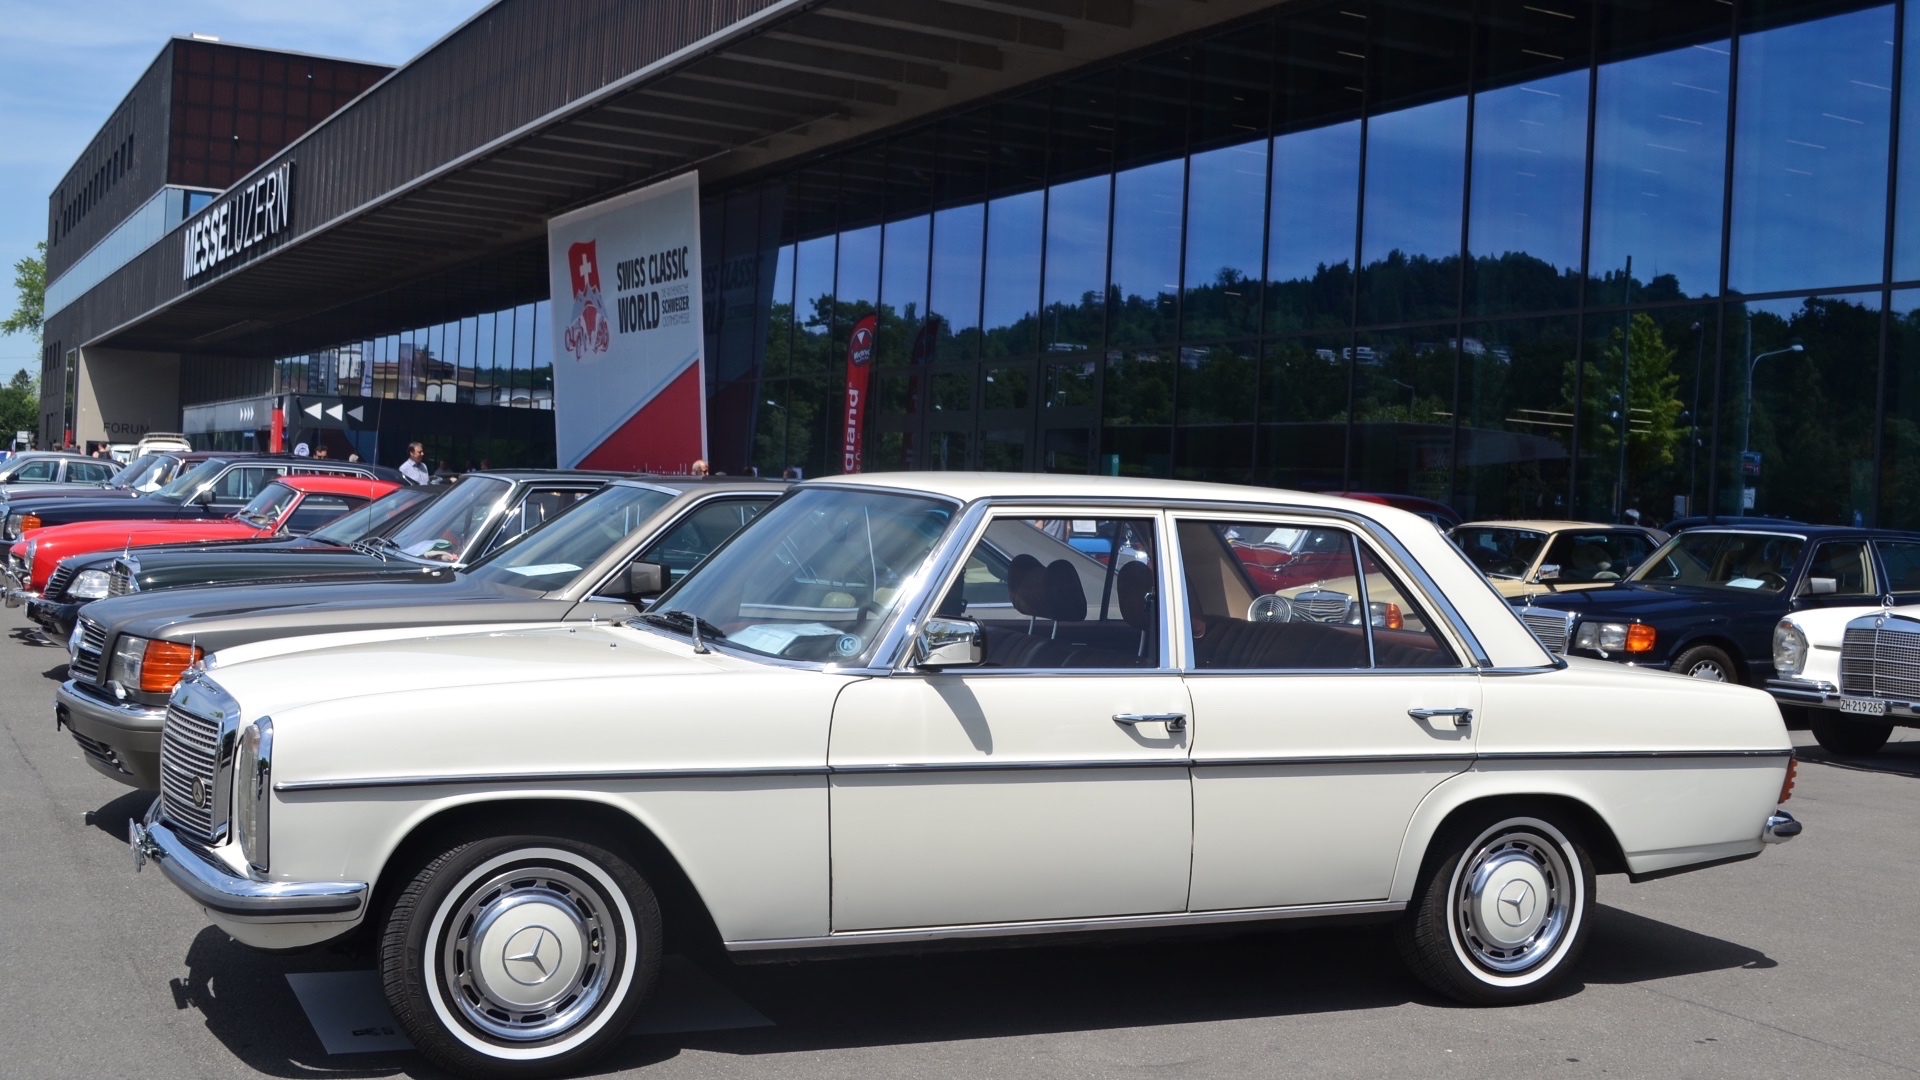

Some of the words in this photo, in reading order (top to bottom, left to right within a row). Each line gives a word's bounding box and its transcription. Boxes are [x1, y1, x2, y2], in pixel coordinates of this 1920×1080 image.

[617, 256, 646, 292] SWISS
[648, 245, 689, 286] CLASSIC
[617, 291, 660, 334] WORLD
[661, 295, 690, 315] SCHWEIZER
[103, 422, 150, 436] FORUM
